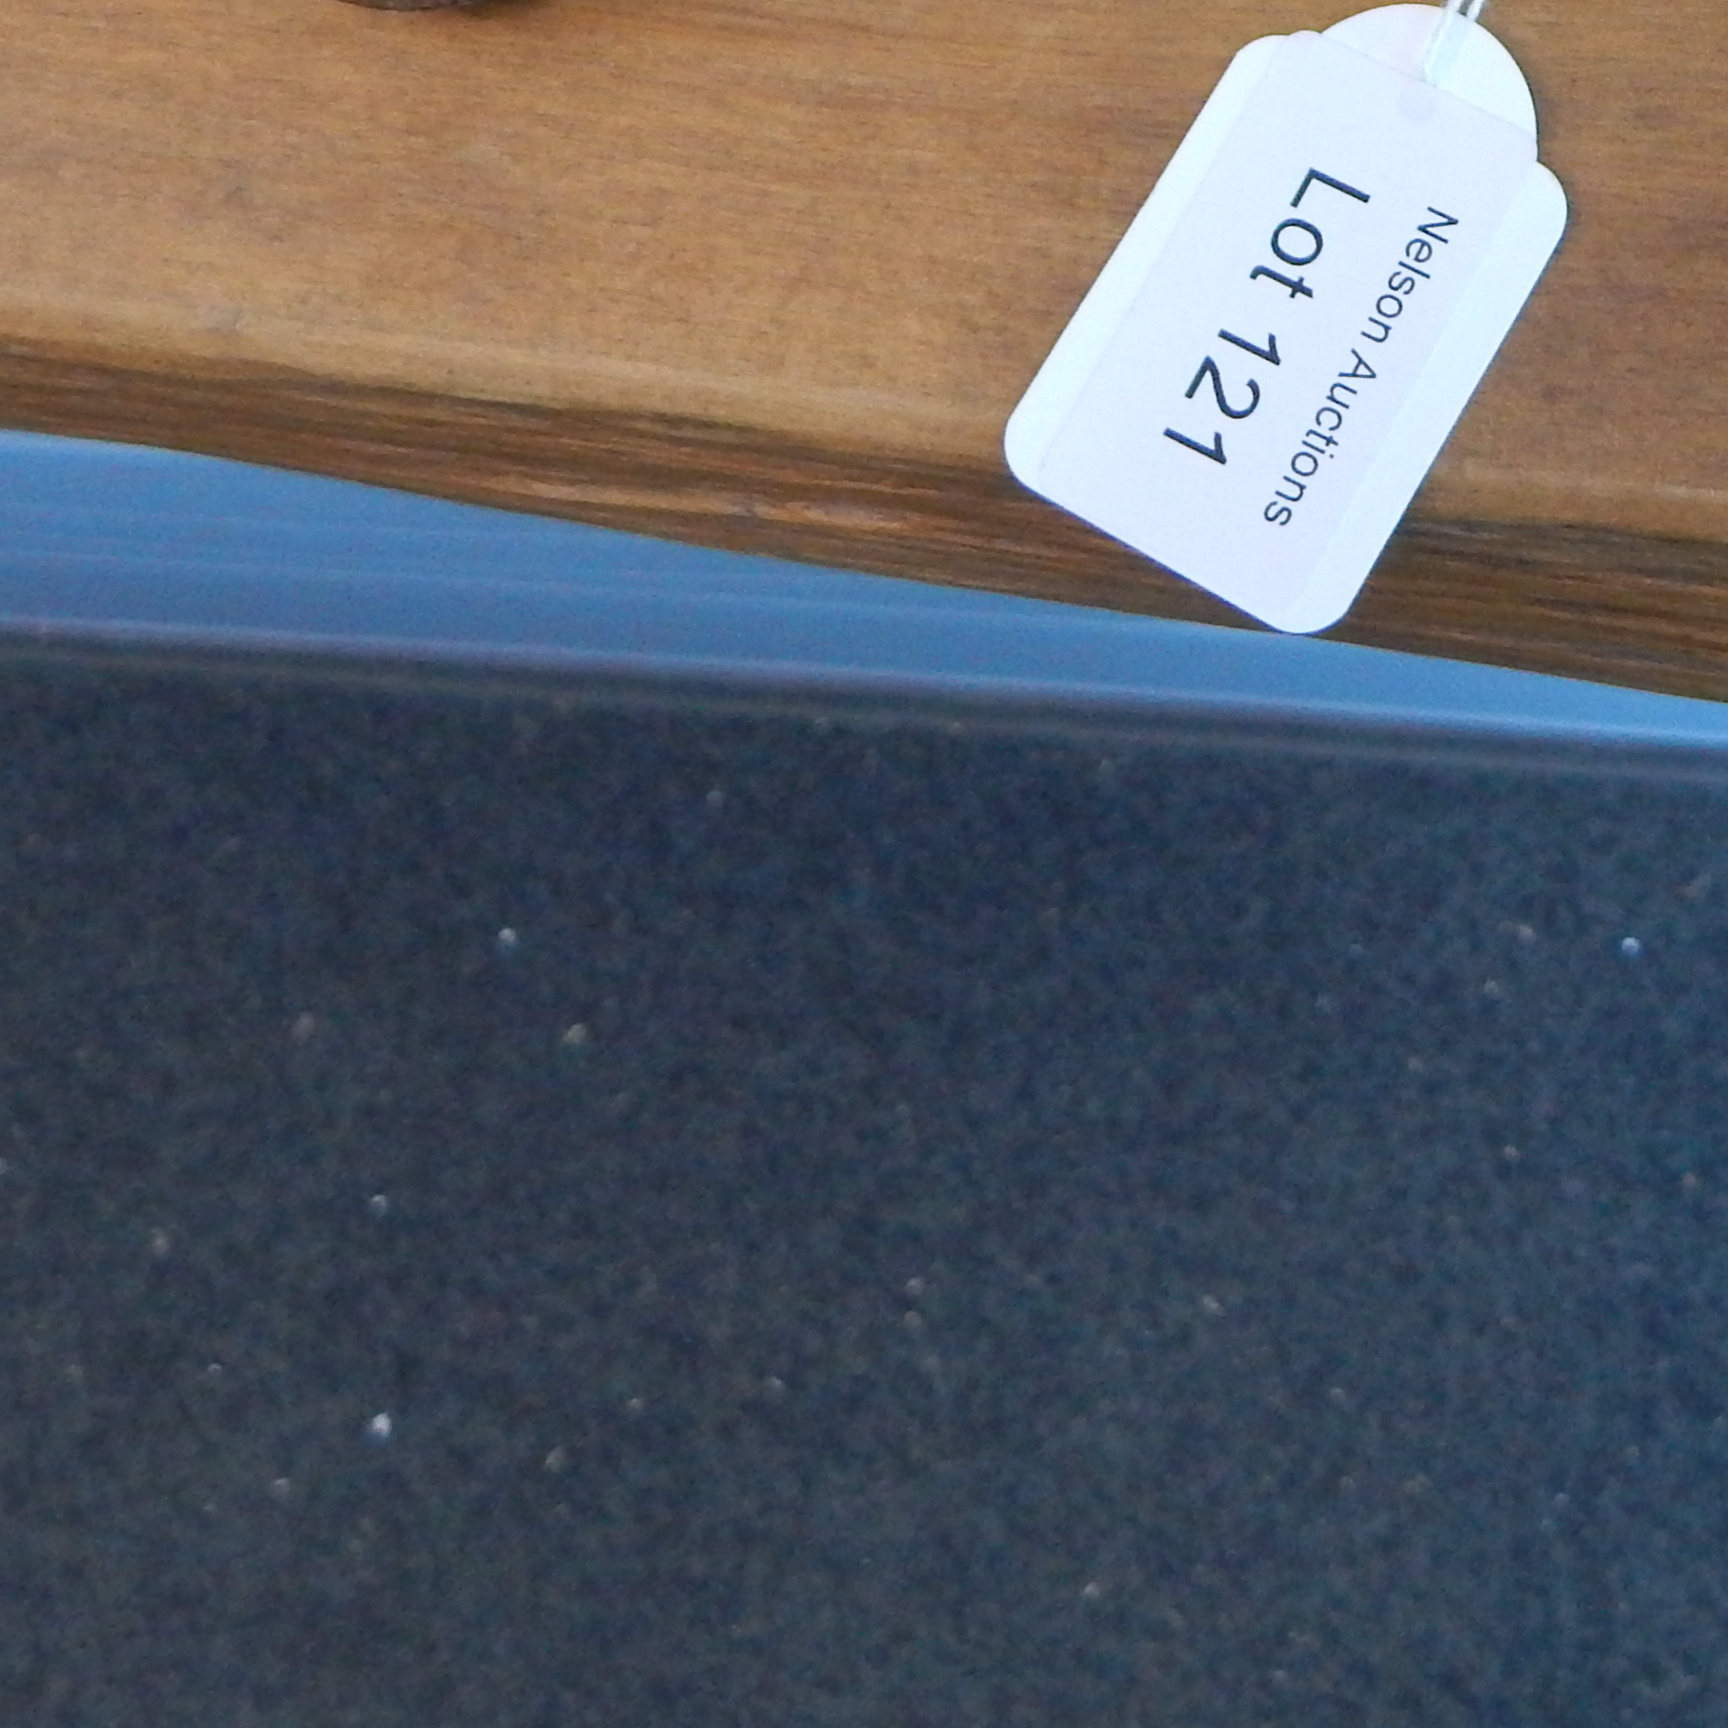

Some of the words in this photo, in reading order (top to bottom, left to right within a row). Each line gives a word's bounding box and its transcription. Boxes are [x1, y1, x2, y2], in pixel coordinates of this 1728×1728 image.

[1249, 167, 1371, 299] Lot
[1360, 205, 1460, 344] Nelson
[1163, 329, 1282, 465] 121
[1264, 348, 1378, 526] Auctions
